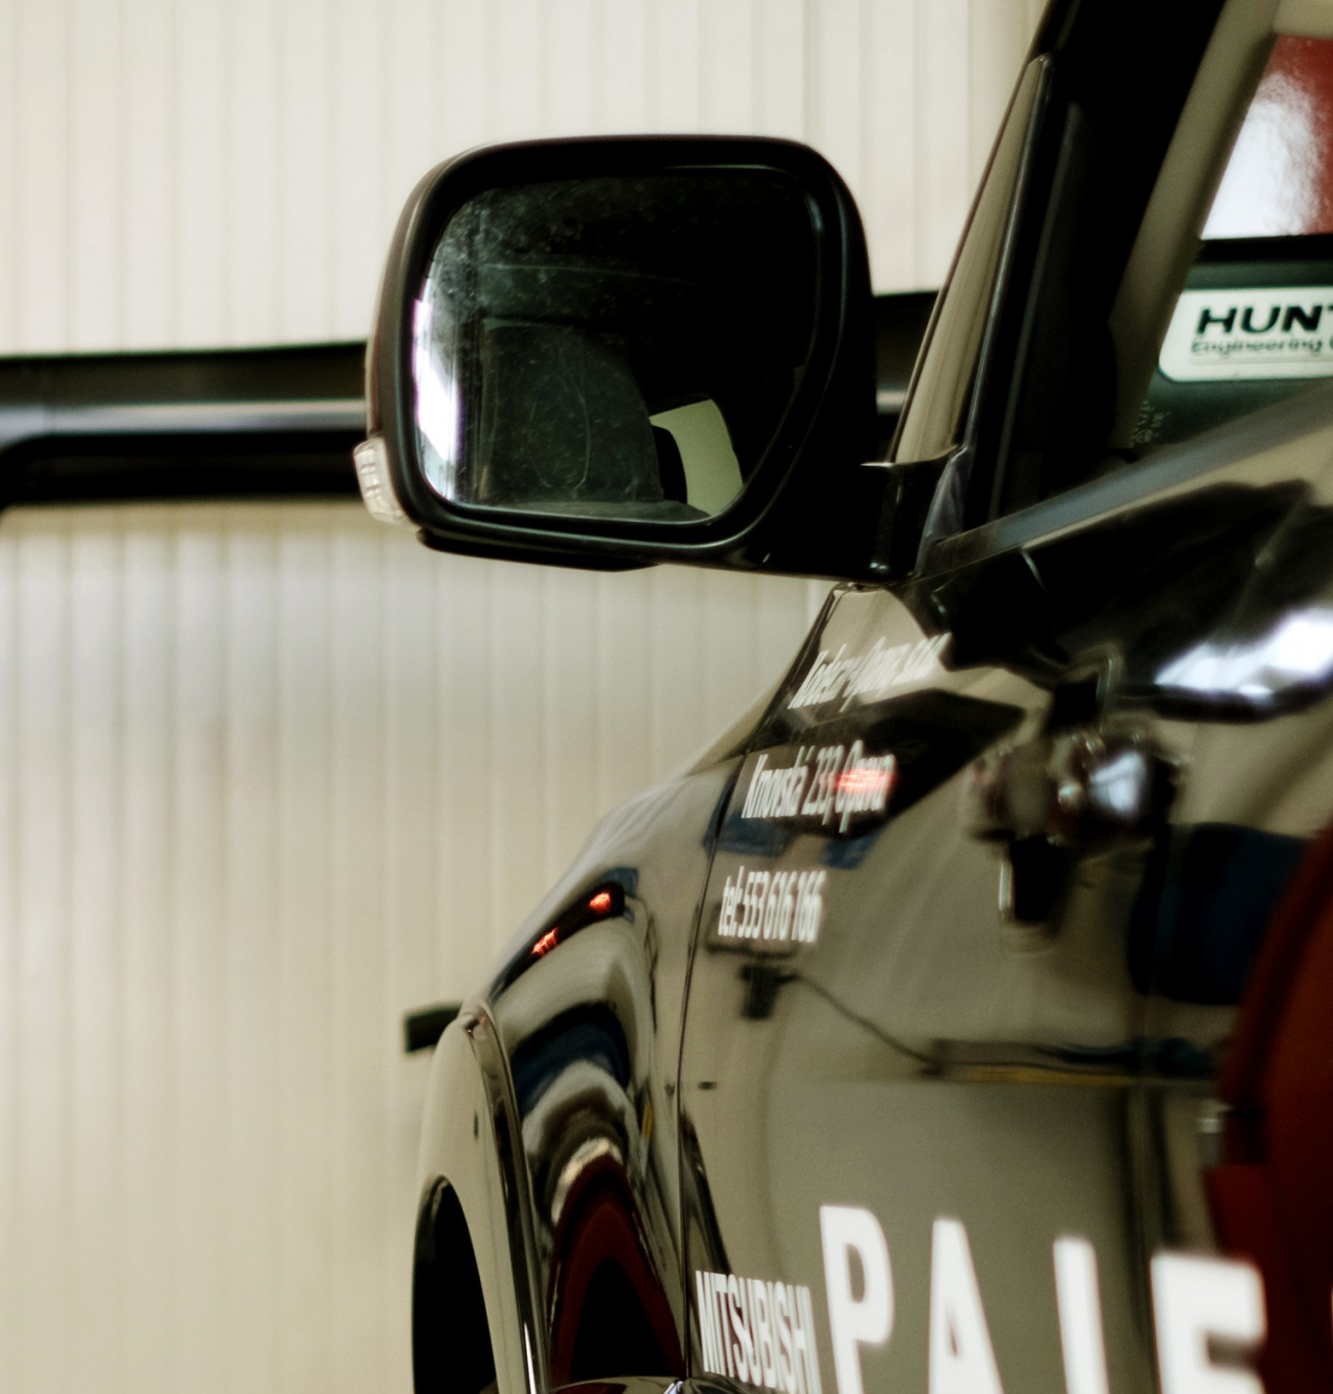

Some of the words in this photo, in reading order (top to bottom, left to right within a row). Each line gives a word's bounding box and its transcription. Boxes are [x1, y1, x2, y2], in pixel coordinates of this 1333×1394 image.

[1196, 304, 1333, 335] HUN
[1190, 338, 1324, 354] Engineering
[801, 745, 845, 825] 233,
[835, 738, 896, 833] Opava
[737, 870, 770, 939] 553
[763, 871, 797, 941] 616
[791, 870, 827, 944] 166
